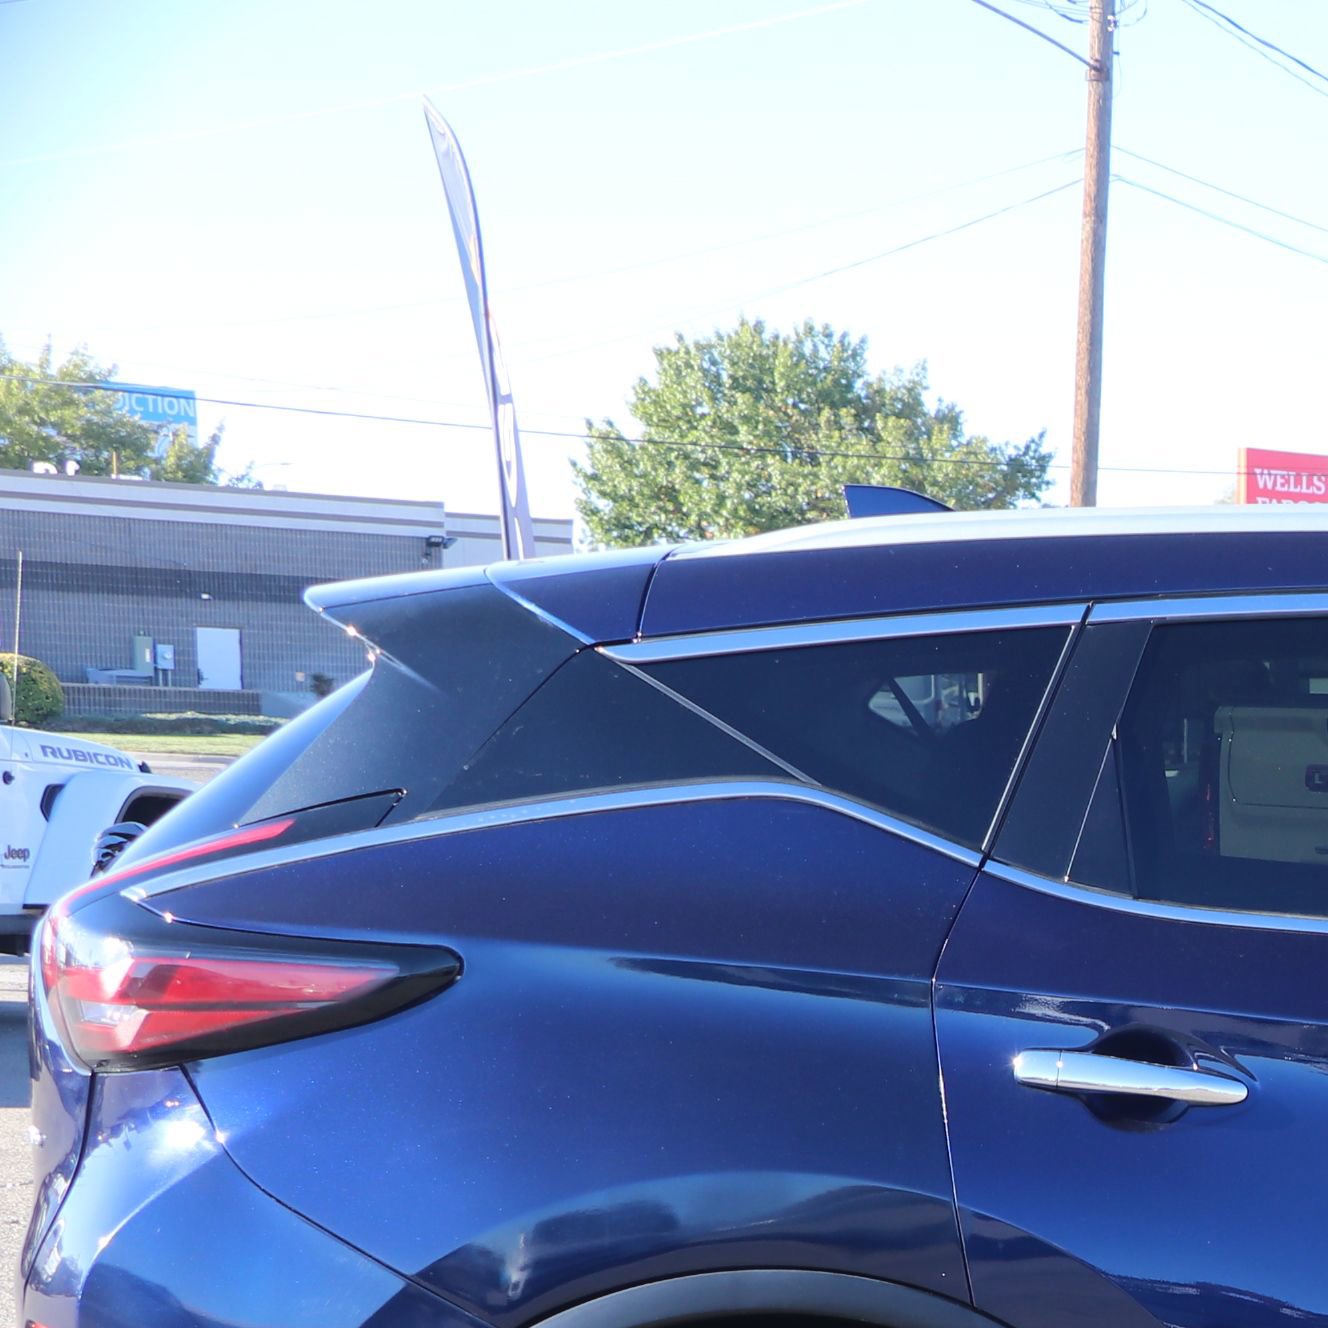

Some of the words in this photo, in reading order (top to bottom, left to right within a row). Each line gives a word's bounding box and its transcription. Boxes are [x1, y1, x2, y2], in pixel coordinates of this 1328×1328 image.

[1253, 467, 1327, 495] WELLS
[40, 744, 133, 770] RUBICON
[3, 844, 30, 863] Jeep
